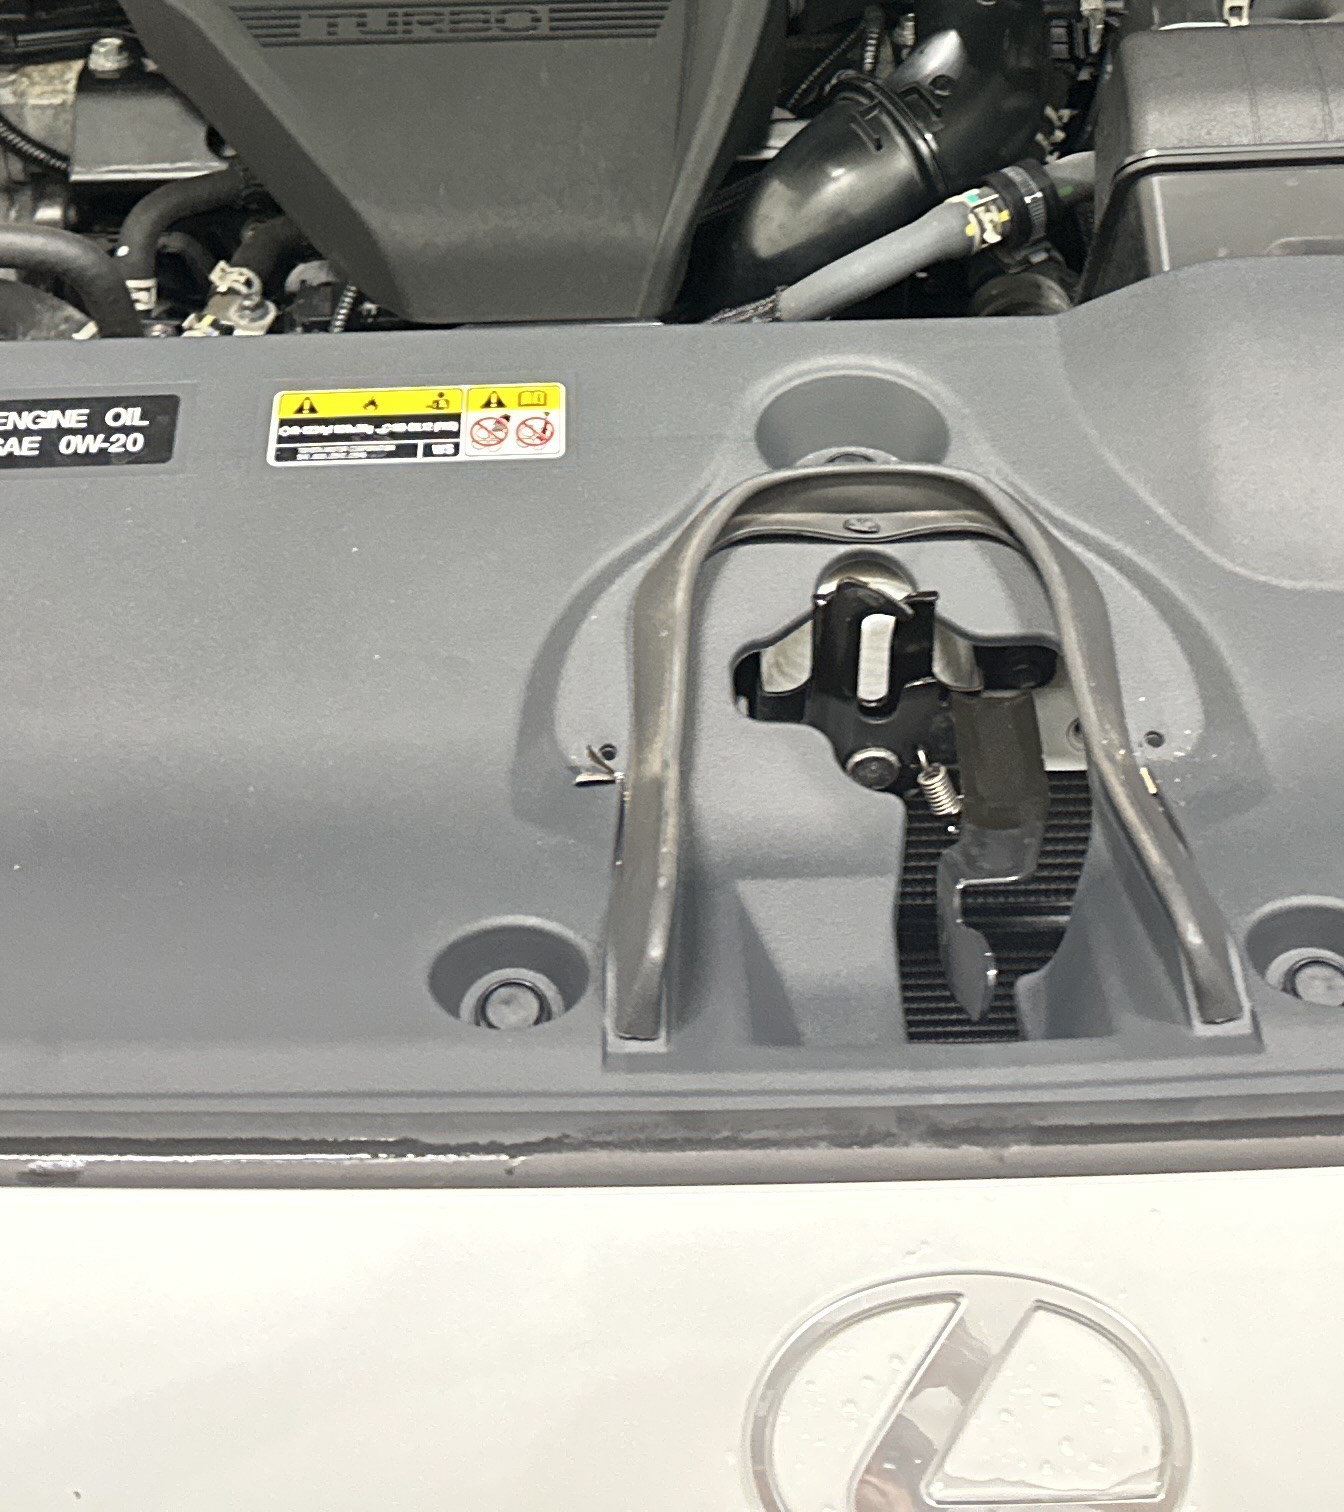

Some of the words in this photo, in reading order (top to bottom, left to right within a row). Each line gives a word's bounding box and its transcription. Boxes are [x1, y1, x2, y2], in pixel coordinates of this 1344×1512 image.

[307, 6, 543, 37] TURBO
[104, 406, 150, 427] OIL
[58, 432, 145, 455] 0W-20
